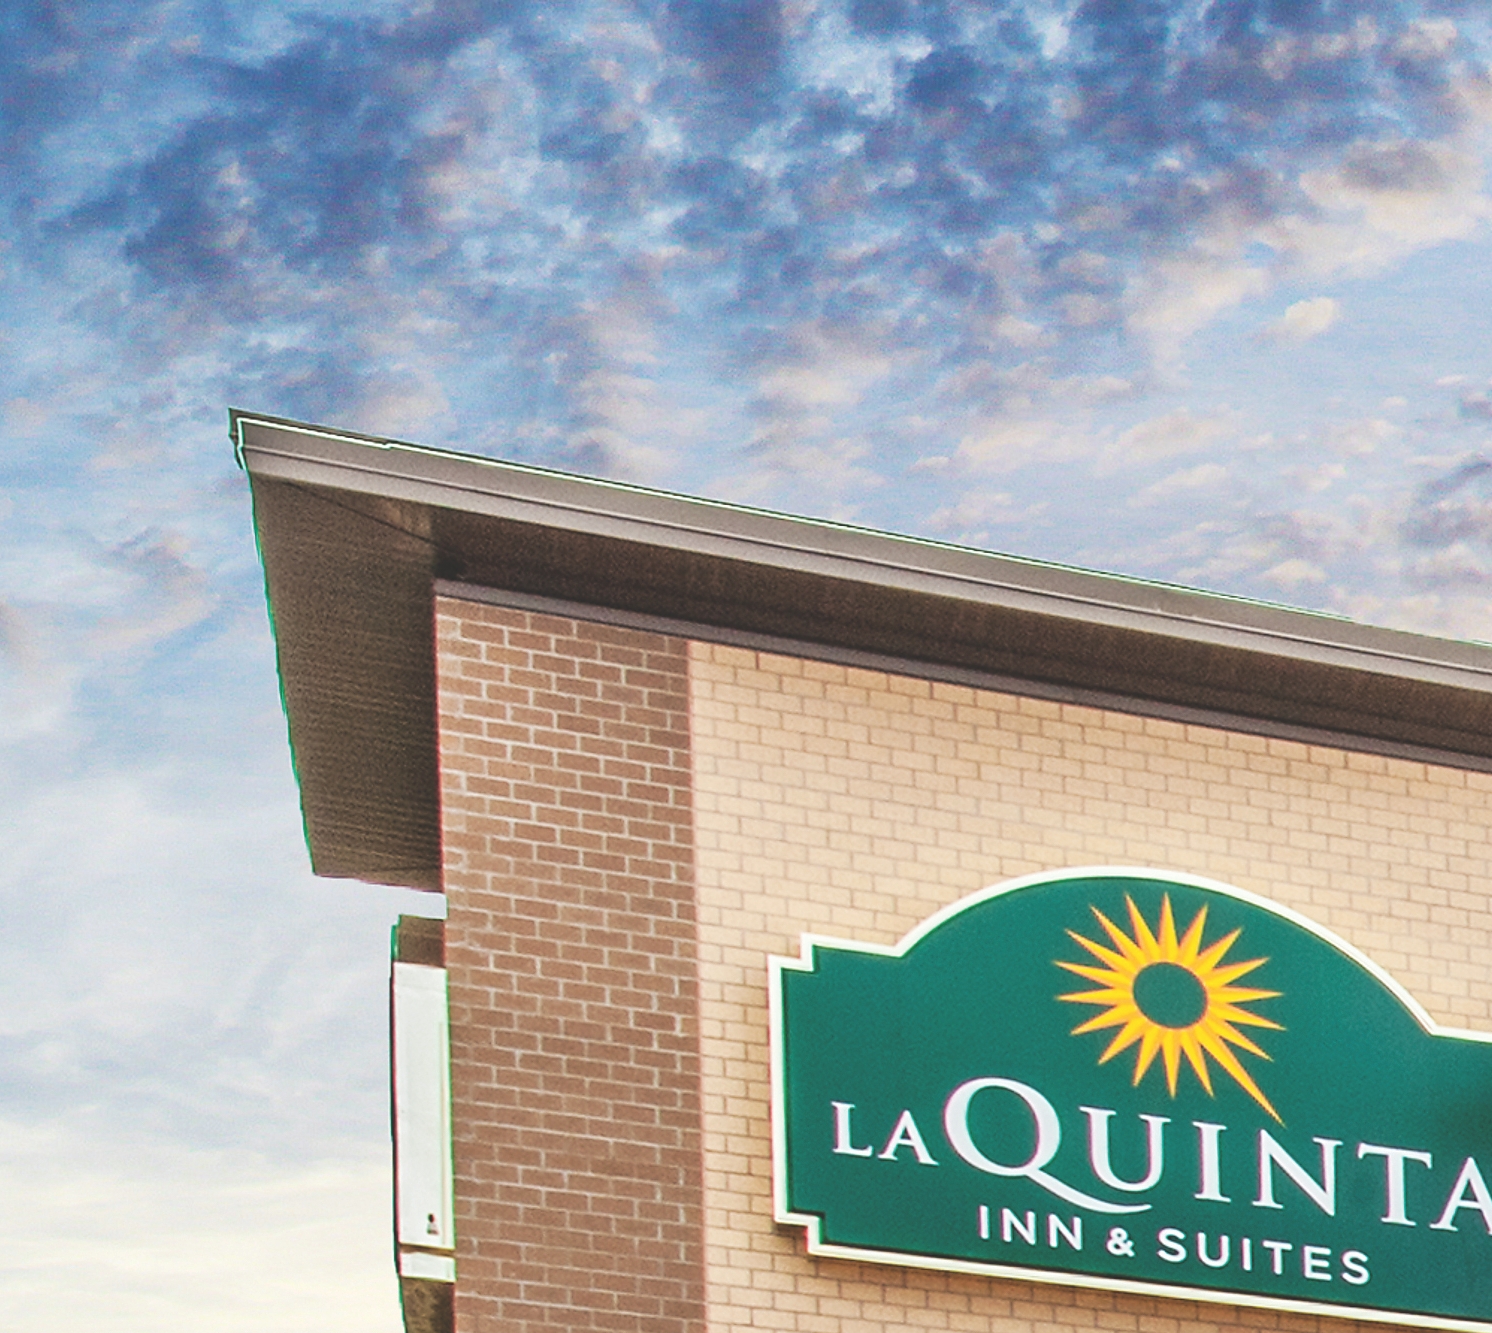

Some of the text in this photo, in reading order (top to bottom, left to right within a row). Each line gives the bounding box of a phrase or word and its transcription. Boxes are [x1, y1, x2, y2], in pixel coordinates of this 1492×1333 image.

[979, 1205, 1370, 1286] INN & SUITES
